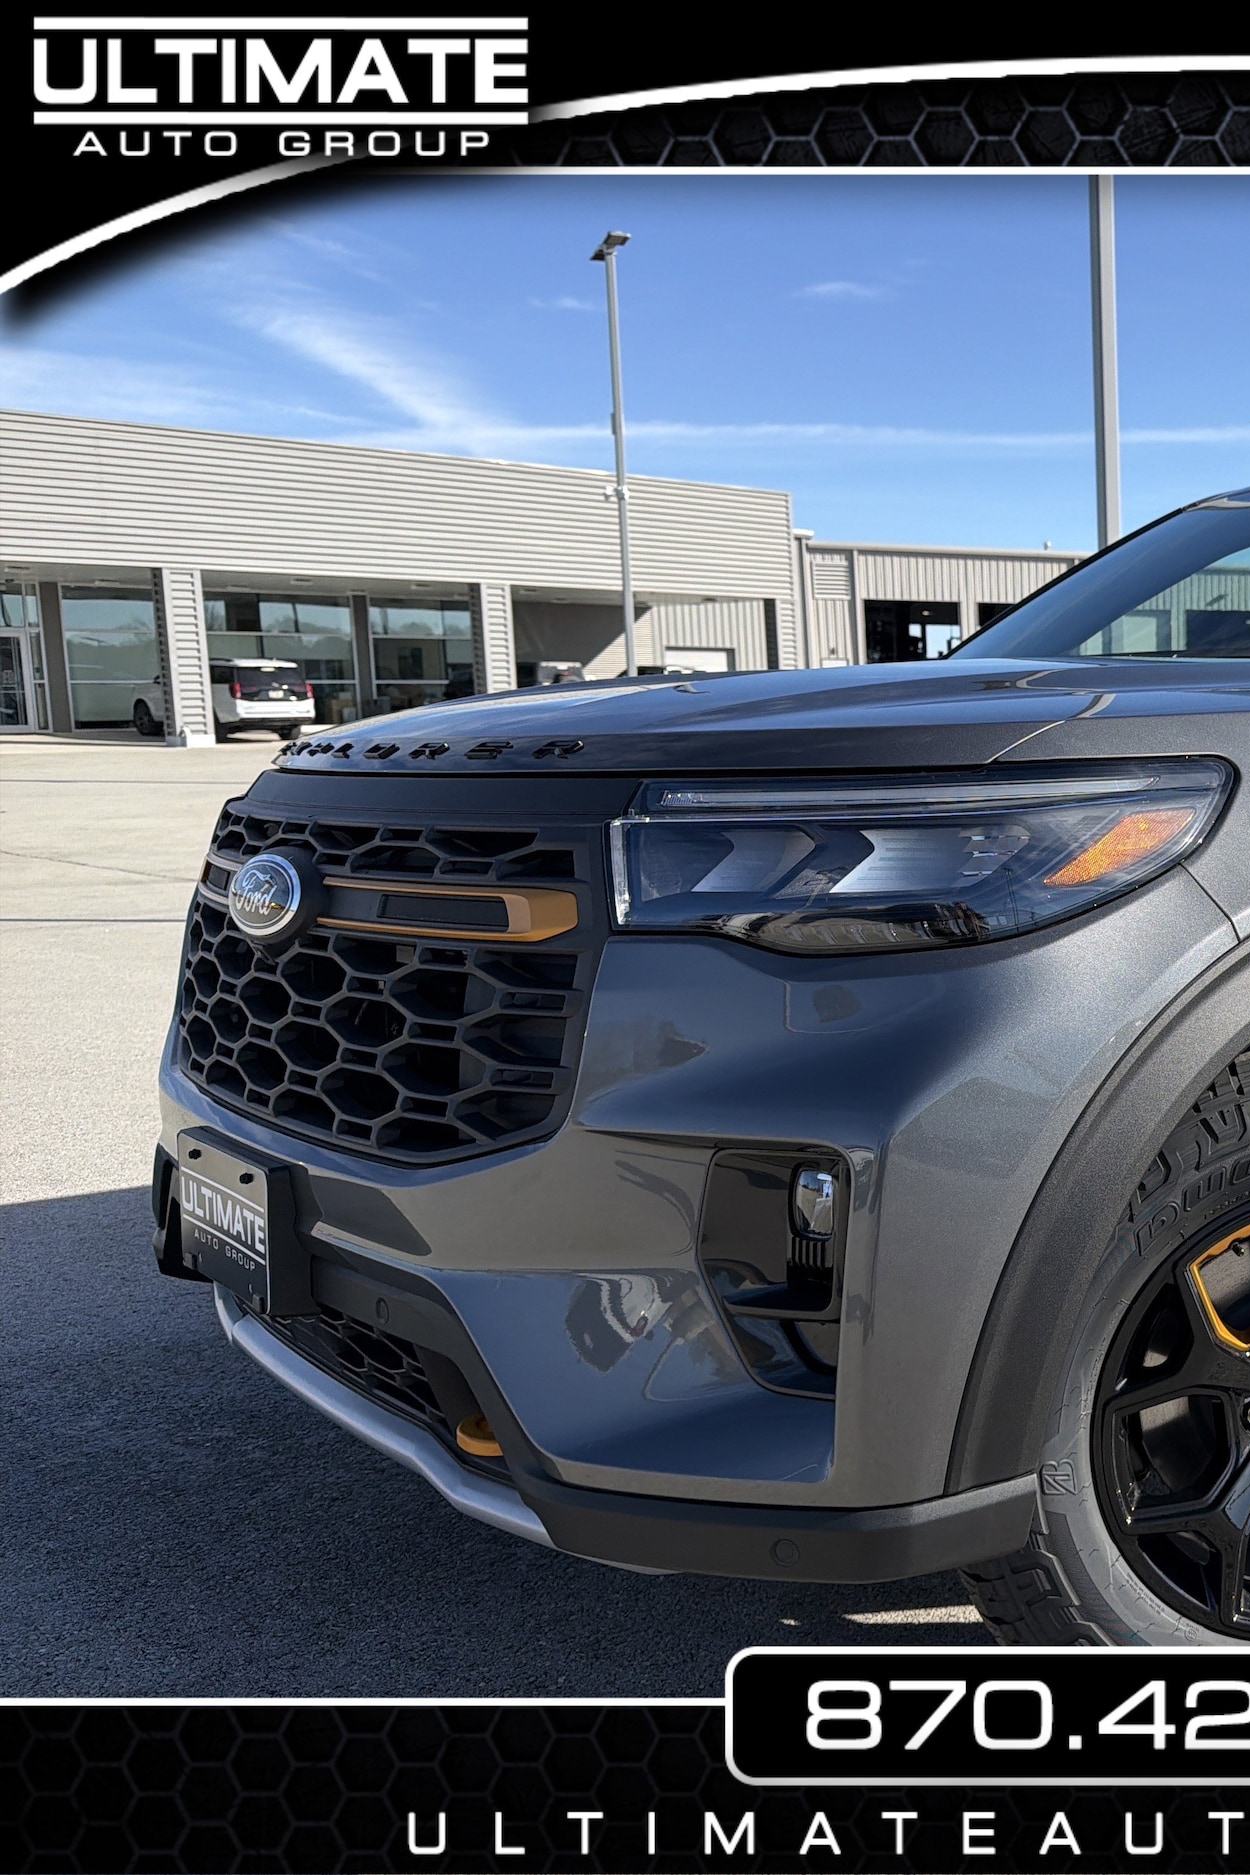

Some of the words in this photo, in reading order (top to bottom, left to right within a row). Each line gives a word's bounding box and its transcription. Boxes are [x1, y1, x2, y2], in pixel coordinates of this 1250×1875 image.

[235, 869, 278, 916] Ford
[180, 1175, 266, 1255] ULTIMATE
[193, 1228, 219, 1251] AUTO
[225, 1244, 257, 1272] GROUP
